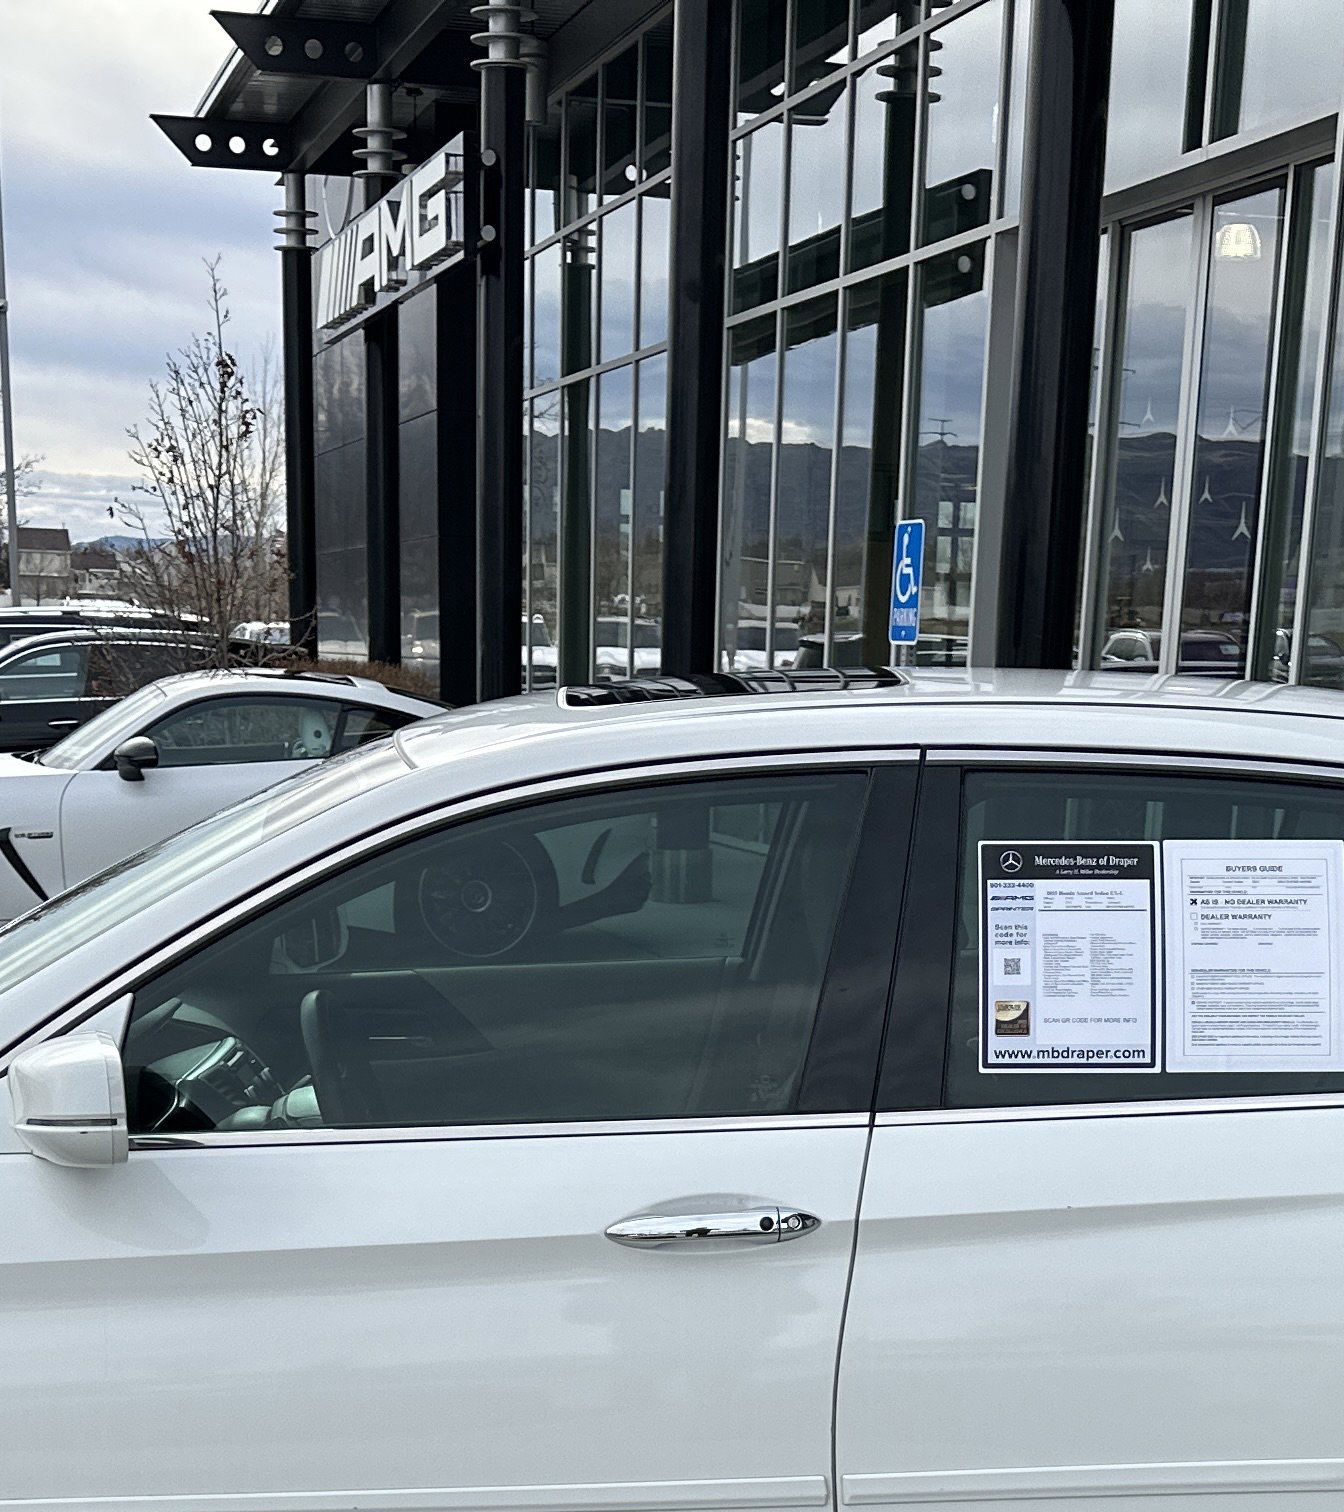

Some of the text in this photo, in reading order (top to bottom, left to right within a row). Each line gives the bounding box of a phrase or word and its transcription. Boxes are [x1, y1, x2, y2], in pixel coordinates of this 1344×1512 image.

[354, 151, 446, 308] AMG
[892, 607, 917, 627] PARKING
[1034, 855, 1139, 868] Mercedes-Benz of Draper
[1225, 865, 1283, 873] BUYERS GUIDE
[1200, 898, 1309, 906] AS IS NO DEALER WARRANTY
[1200, 913, 1272, 921] DEALER WARRANTY
[1014, 923, 1028, 931] this
[993, 1046, 1146, 1061] www.mbdraper.com
